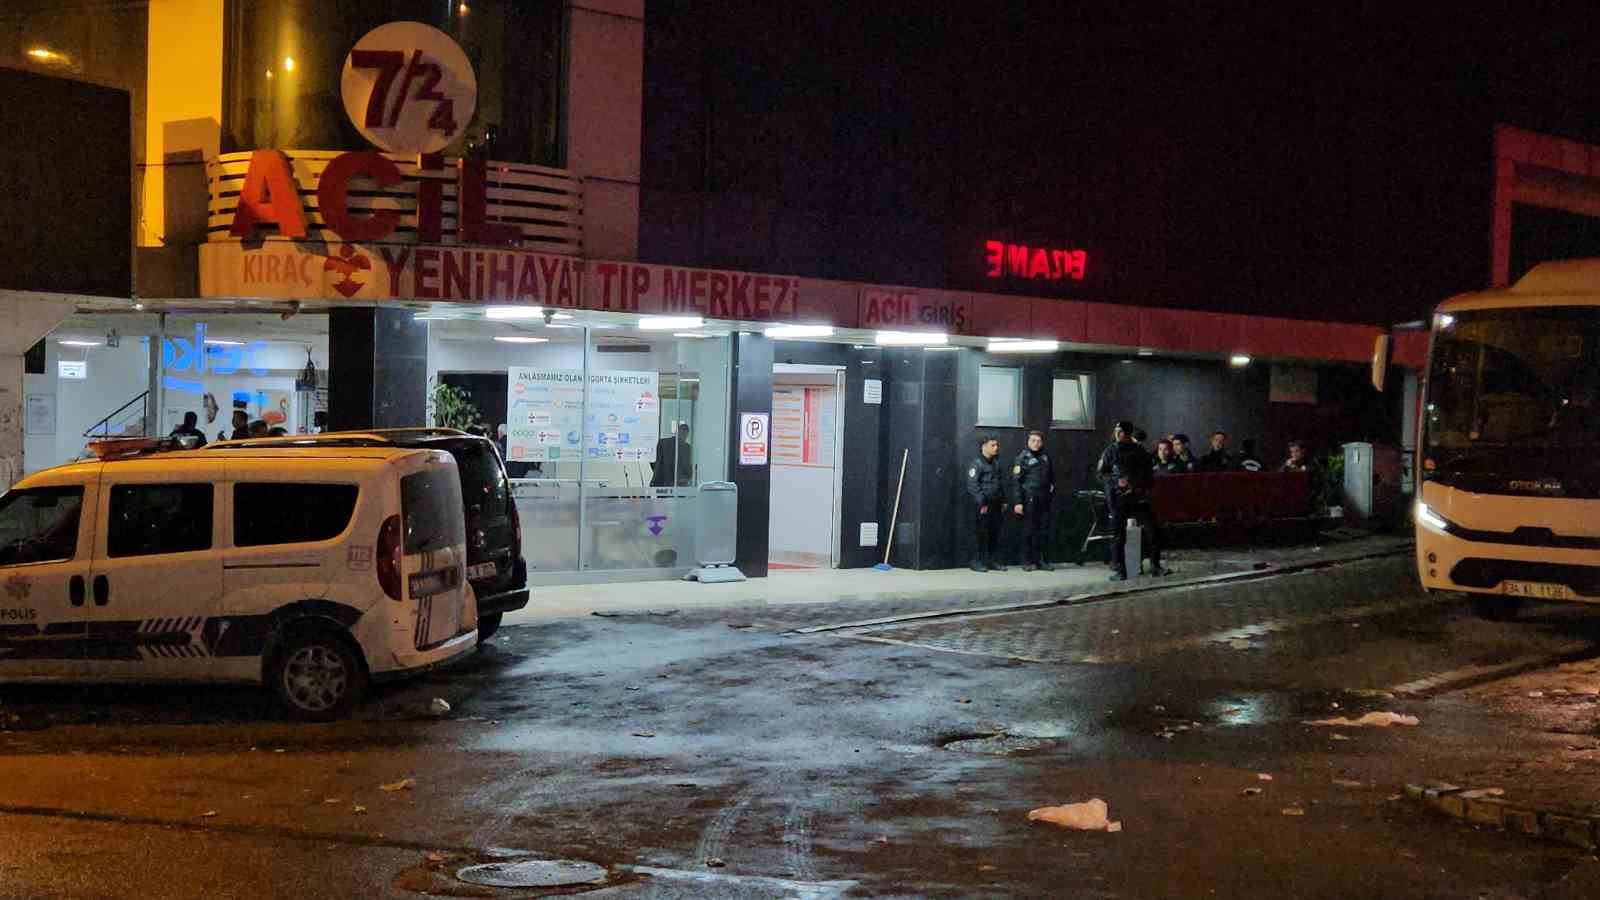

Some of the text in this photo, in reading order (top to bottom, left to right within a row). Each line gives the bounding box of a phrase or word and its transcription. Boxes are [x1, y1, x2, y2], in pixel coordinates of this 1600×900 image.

[351, 49, 458, 136] 7/24
[242, 254, 313, 287] KIRAÇ
[598, 263, 650, 311] TIP
